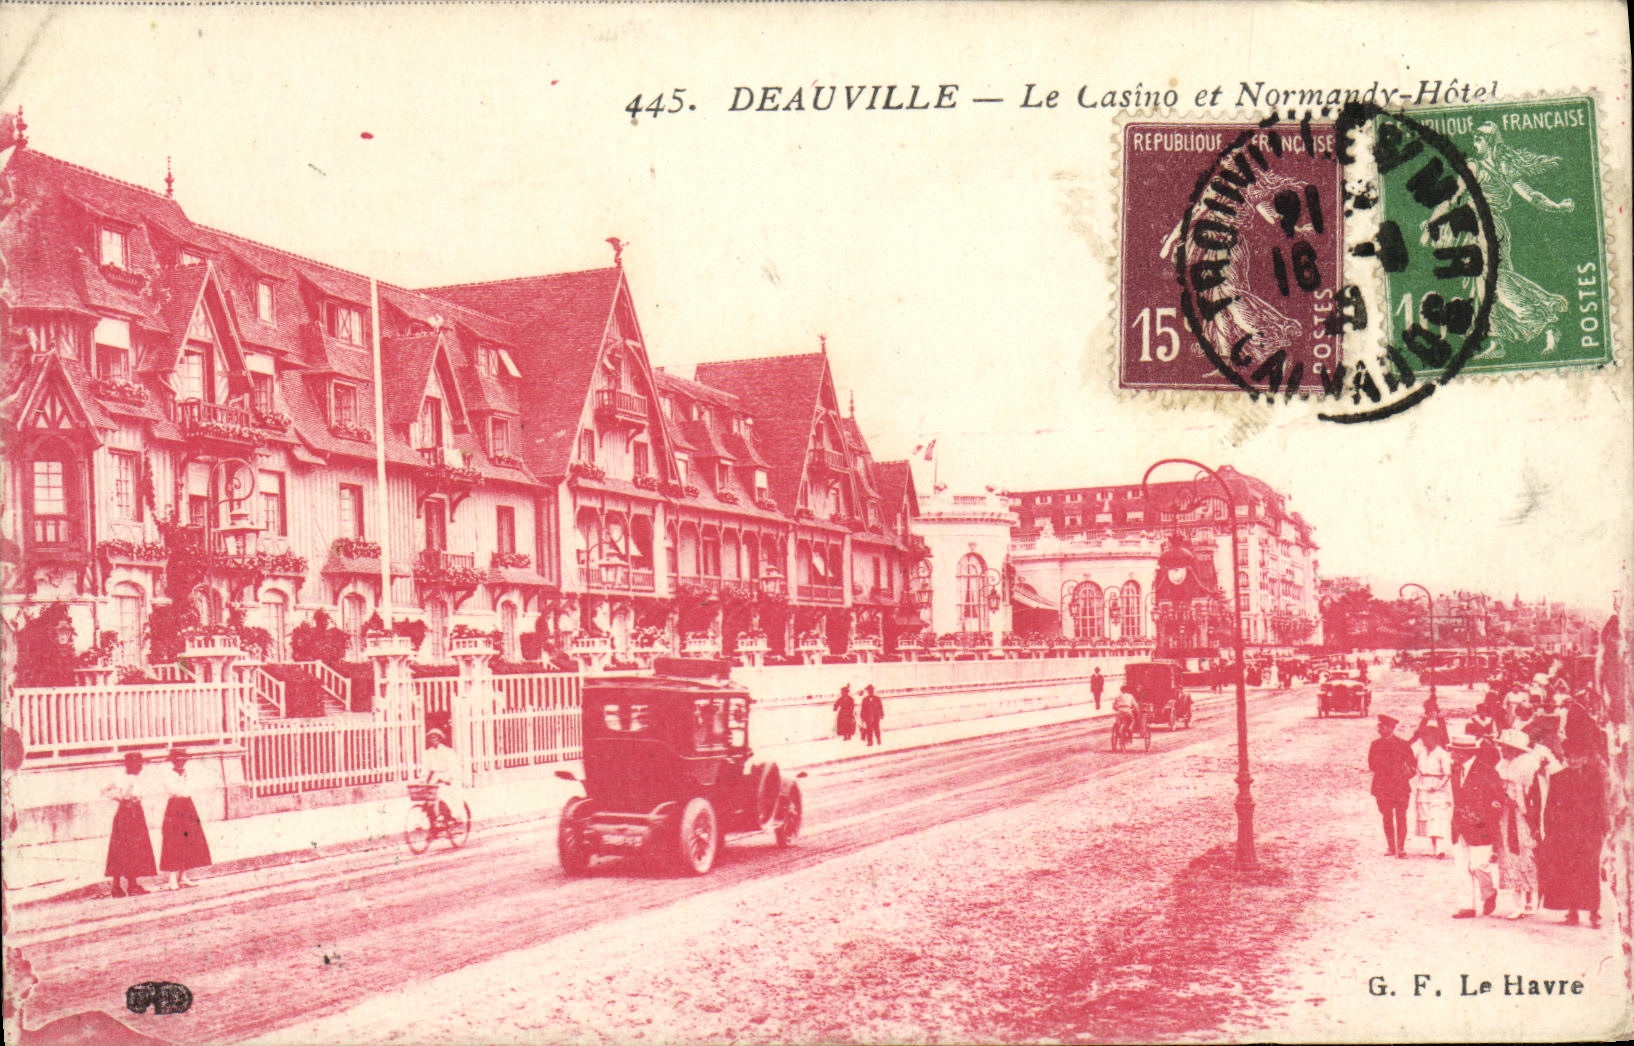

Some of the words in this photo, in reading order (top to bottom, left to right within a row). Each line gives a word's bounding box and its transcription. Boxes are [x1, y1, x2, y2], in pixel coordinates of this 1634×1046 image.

[1251, 133, 1336, 154] FRNÇISE
[1575, 261, 1600, 348] POSTES
[1131, 306, 1181, 363] 15
